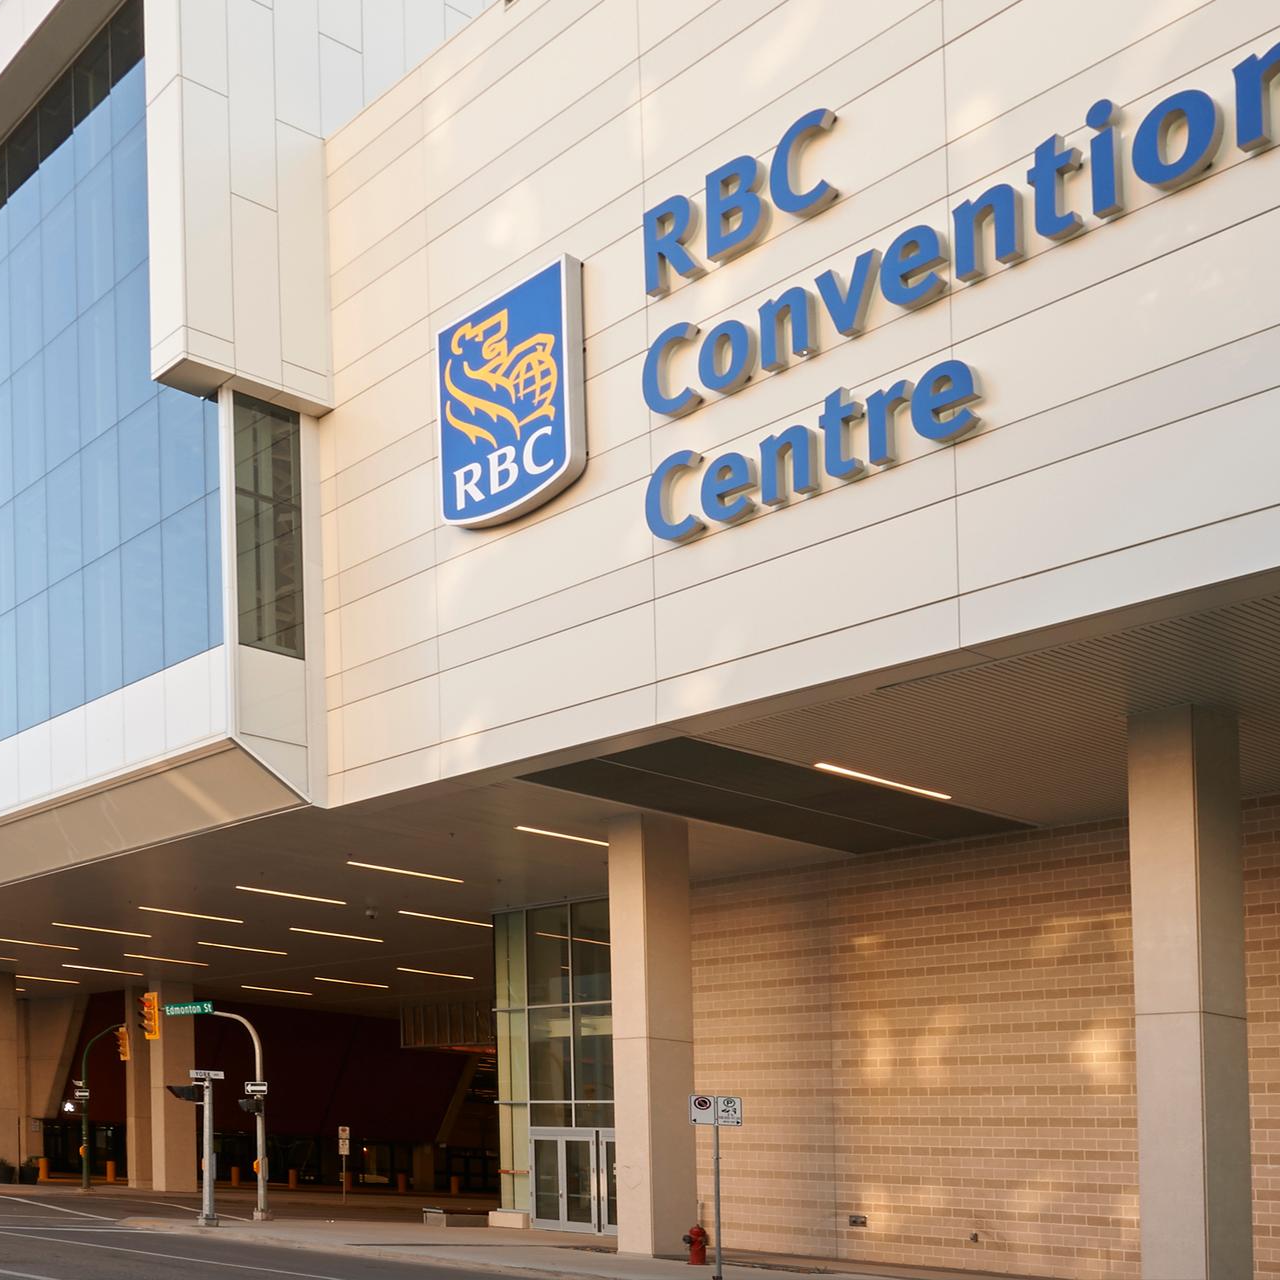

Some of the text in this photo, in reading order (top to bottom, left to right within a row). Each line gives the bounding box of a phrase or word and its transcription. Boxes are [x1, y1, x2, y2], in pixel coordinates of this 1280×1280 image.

[642, 107, 838, 298] RBC
[452, 425, 555, 511] RBC
[644, 359, 983, 543] Centre
[165, 1003, 213, 1016] Edmonton St
